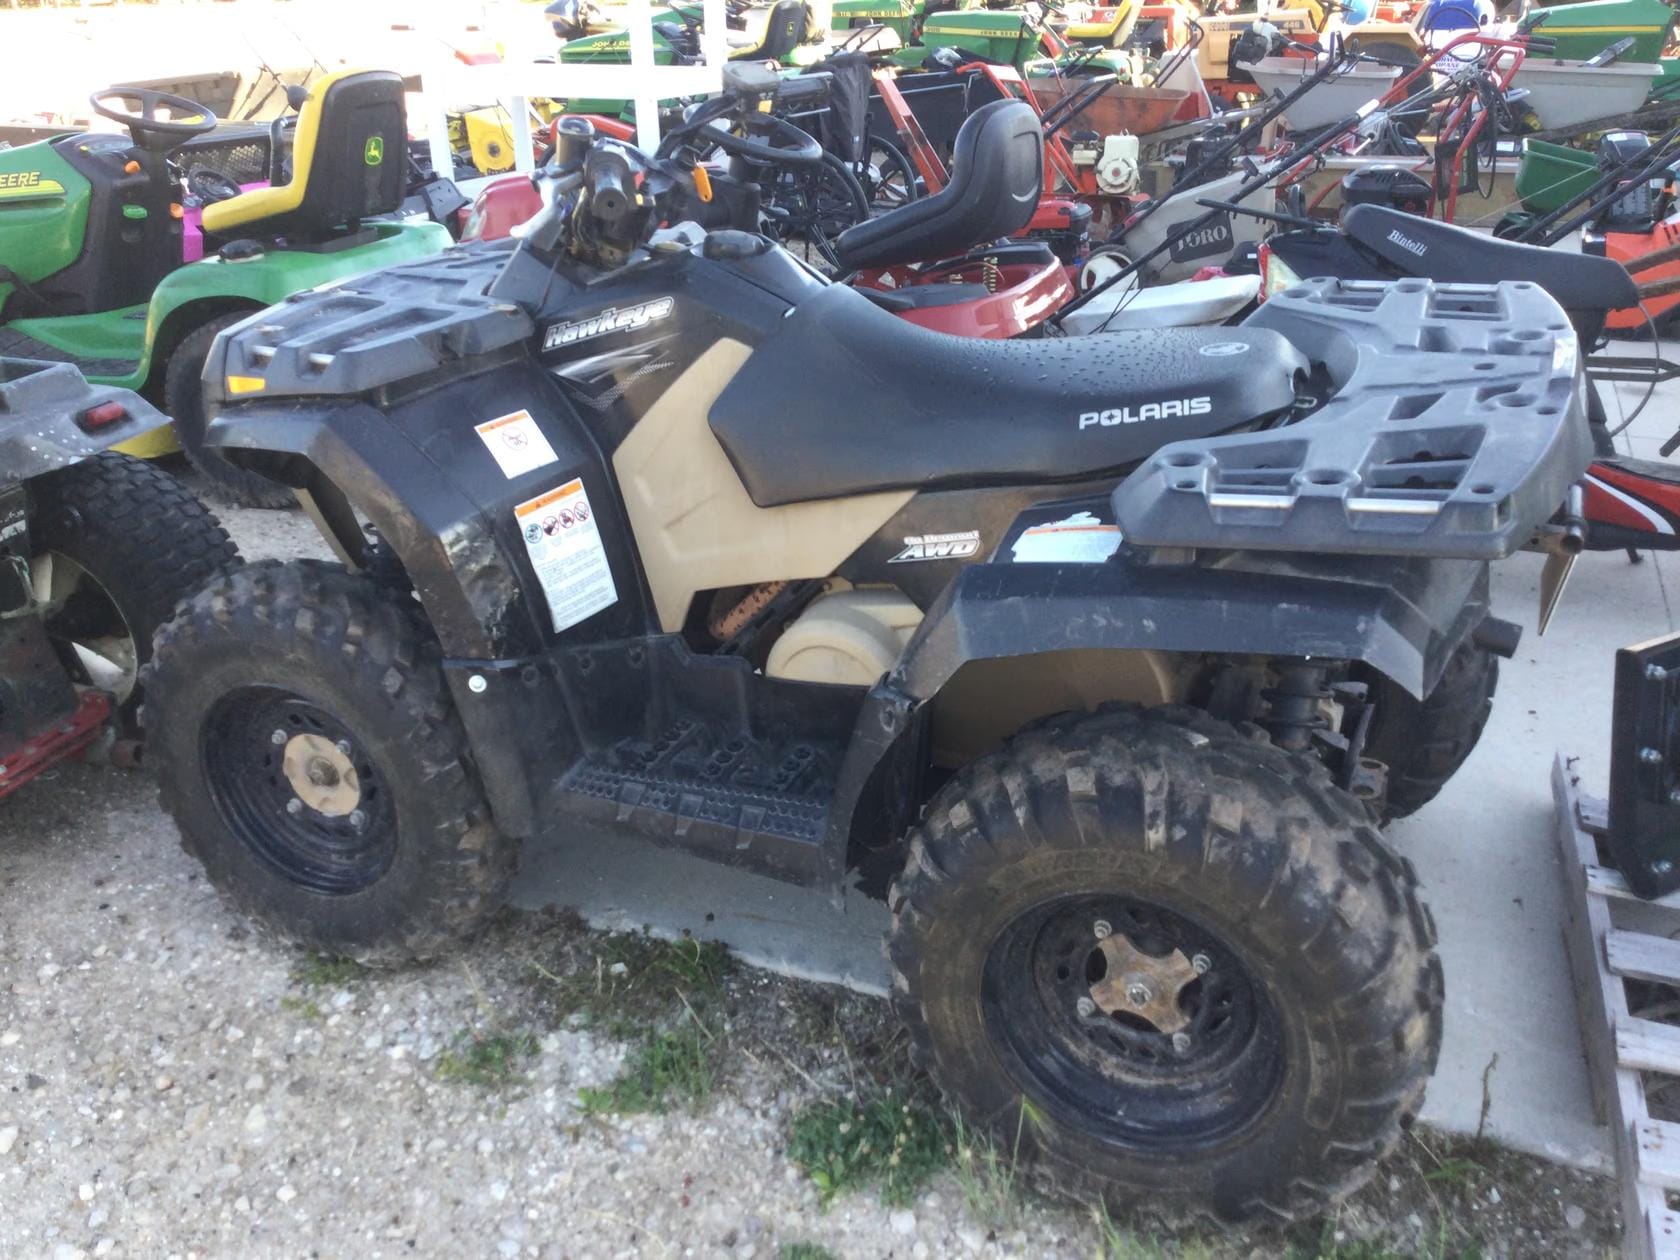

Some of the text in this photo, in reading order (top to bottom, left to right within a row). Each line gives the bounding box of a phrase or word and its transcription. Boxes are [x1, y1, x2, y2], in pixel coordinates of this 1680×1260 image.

[1387, 229, 1428, 257] Bintelli
[543, 297, 673, 351] Hawkeye
[1079, 396, 1212, 430] POLARIS
[897, 541, 979, 560] AWD
